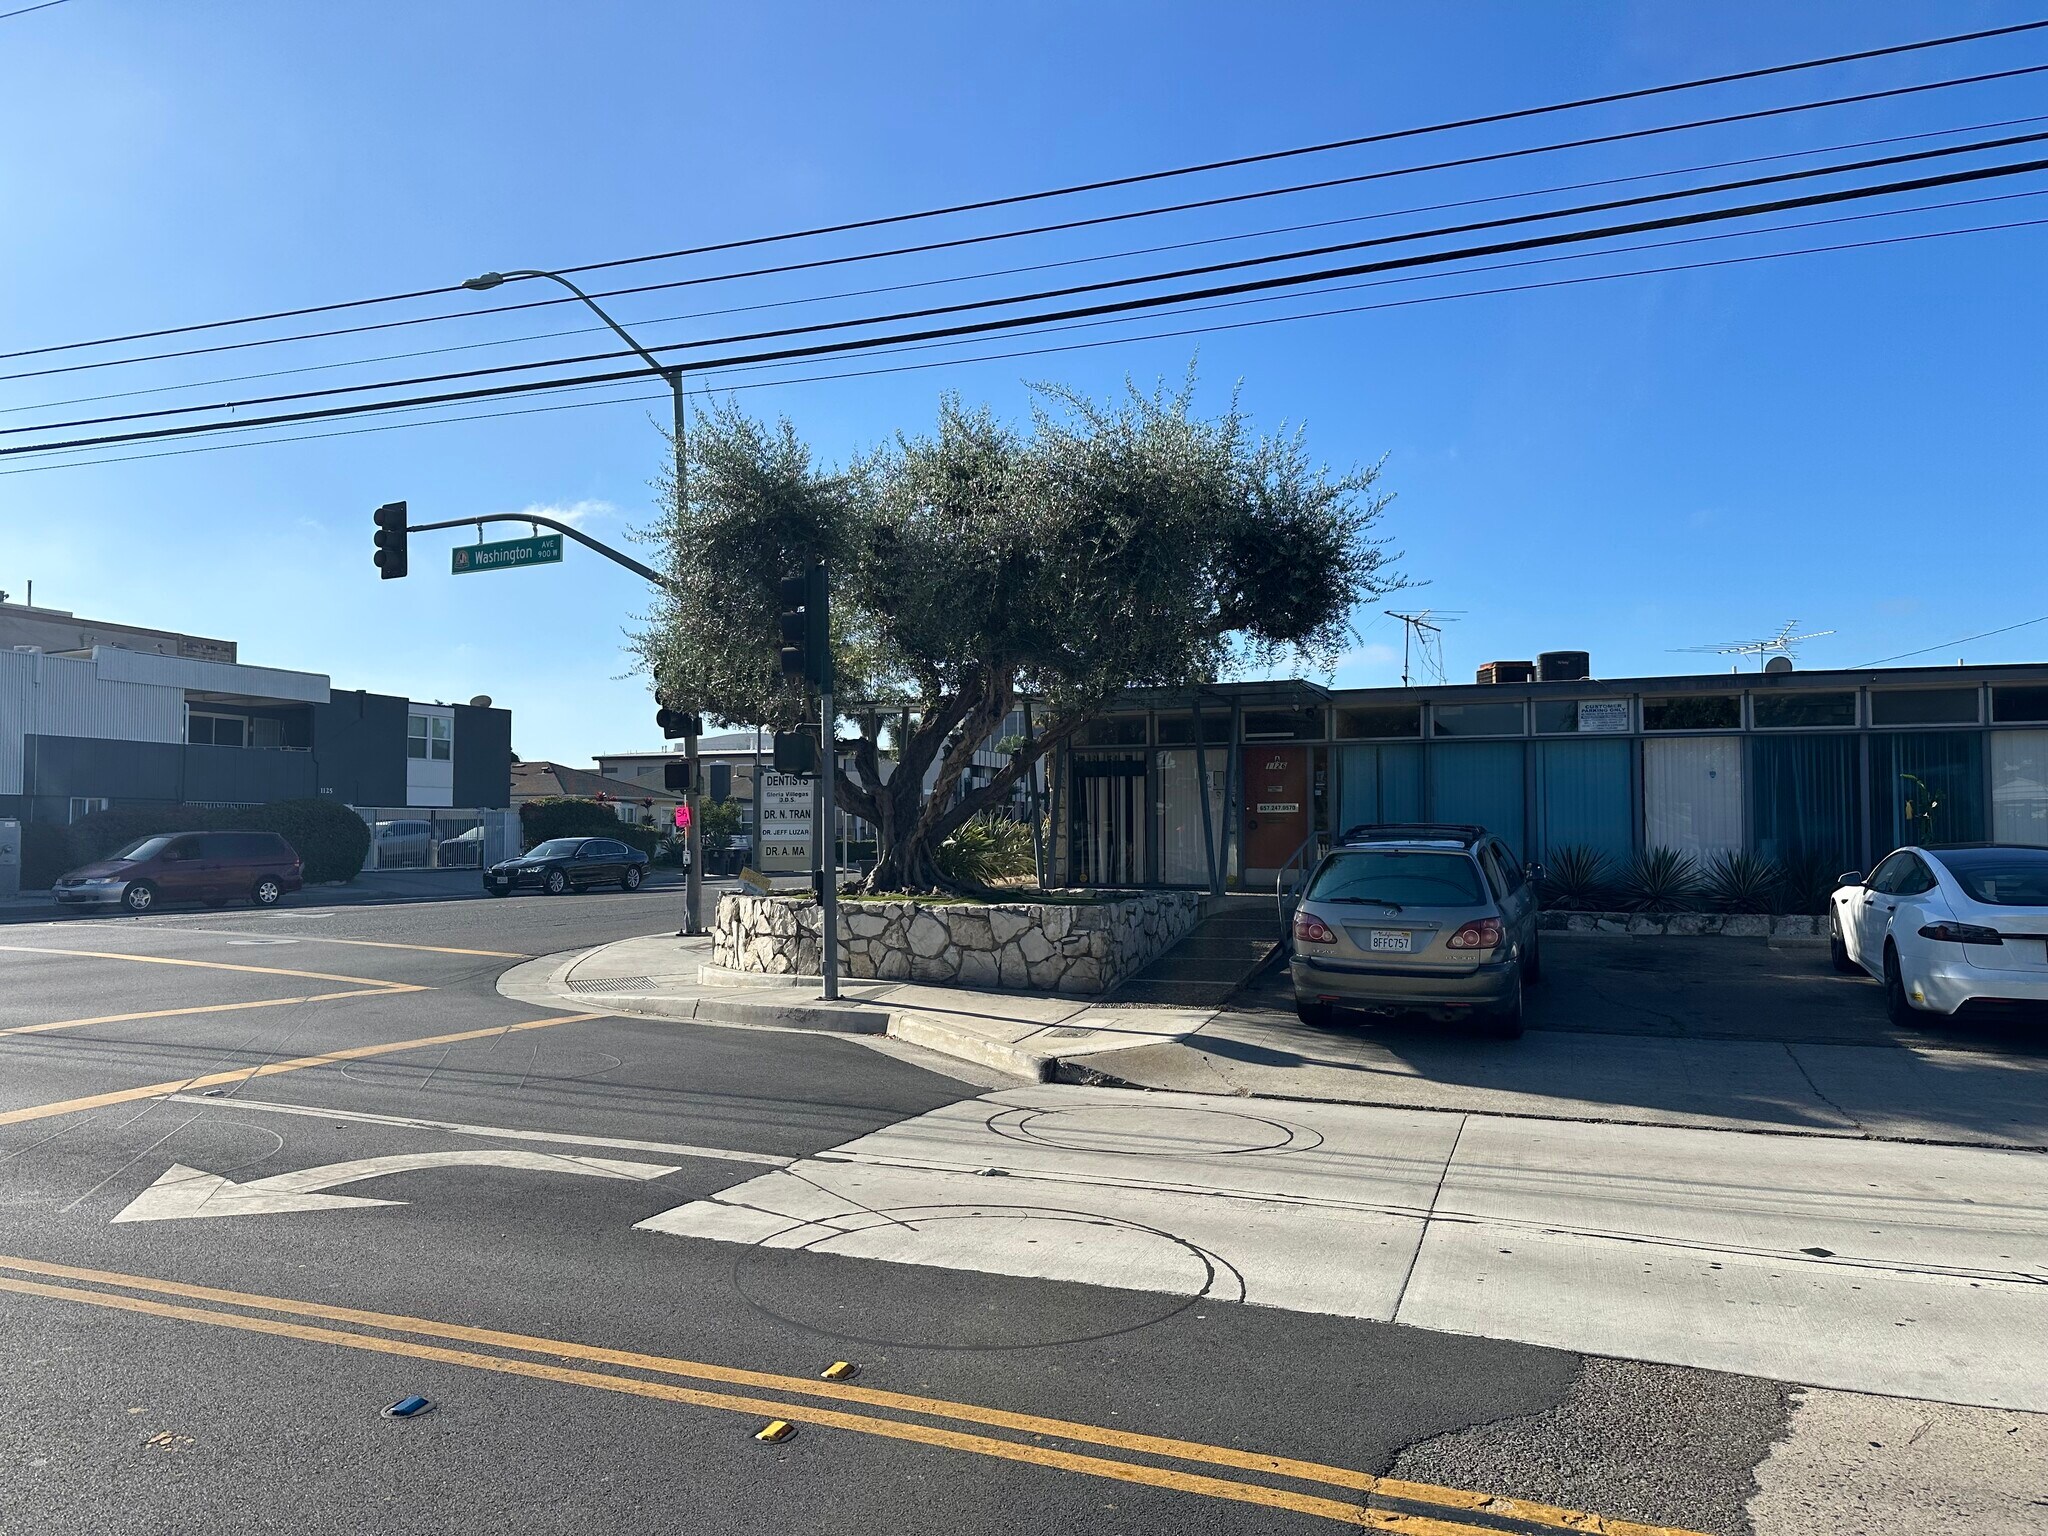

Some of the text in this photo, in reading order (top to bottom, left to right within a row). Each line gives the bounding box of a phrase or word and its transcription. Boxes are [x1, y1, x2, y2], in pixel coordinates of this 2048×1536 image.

[541, 540, 554, 548] AVE
[475, 547, 533, 565] Washington
[537, 549, 558, 558] 900 W
[764, 810, 811, 819] DR. N. TRAN
[766, 847, 805, 856] DR. A. MA
[1373, 938, 1408, 948] 8FFC757
